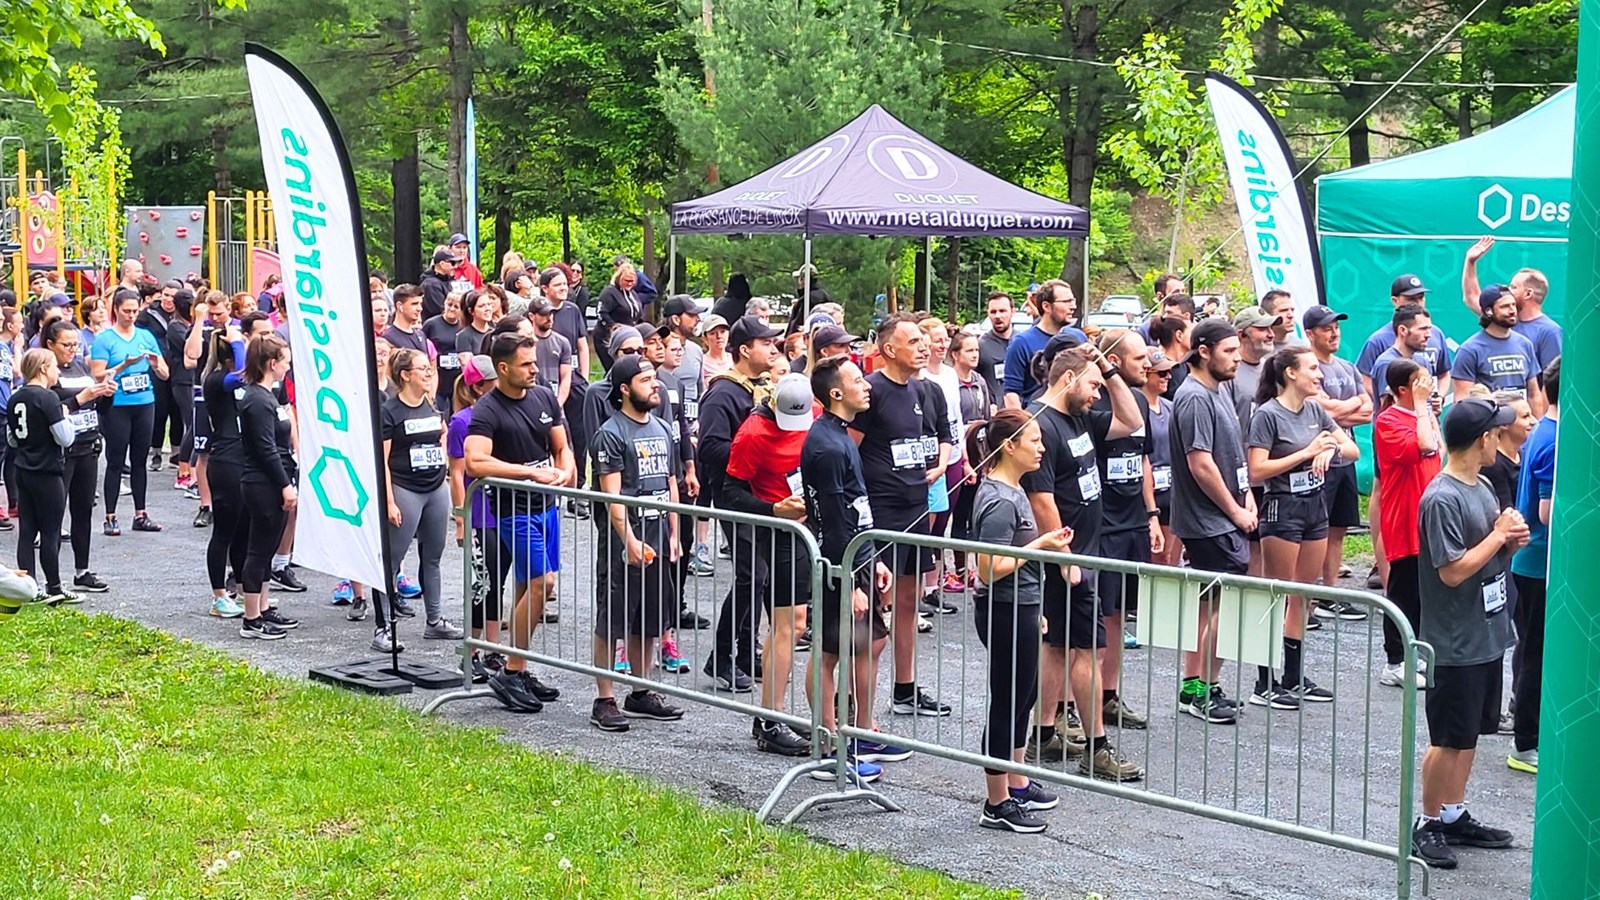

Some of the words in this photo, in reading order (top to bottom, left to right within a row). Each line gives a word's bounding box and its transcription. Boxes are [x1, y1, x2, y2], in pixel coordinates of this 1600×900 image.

[885, 147, 940, 180] D
[894, 192, 978, 206] DUQUET
[1519, 193, 1571, 223] Des
[674, 211, 687, 227] LA
[688, 208, 747, 226] PUISSANCE
[748, 208, 765, 226] DE
[826, 210, 1074, 231] www.metalduquet.com
[1492, 358, 1525, 372] RCM
[134, 374, 148, 387] 824
[14, 402, 28, 439] 3
[194, 436, 208, 450] 67
[425, 449, 443, 464] 934
[637, 456, 669, 476] BREAK
